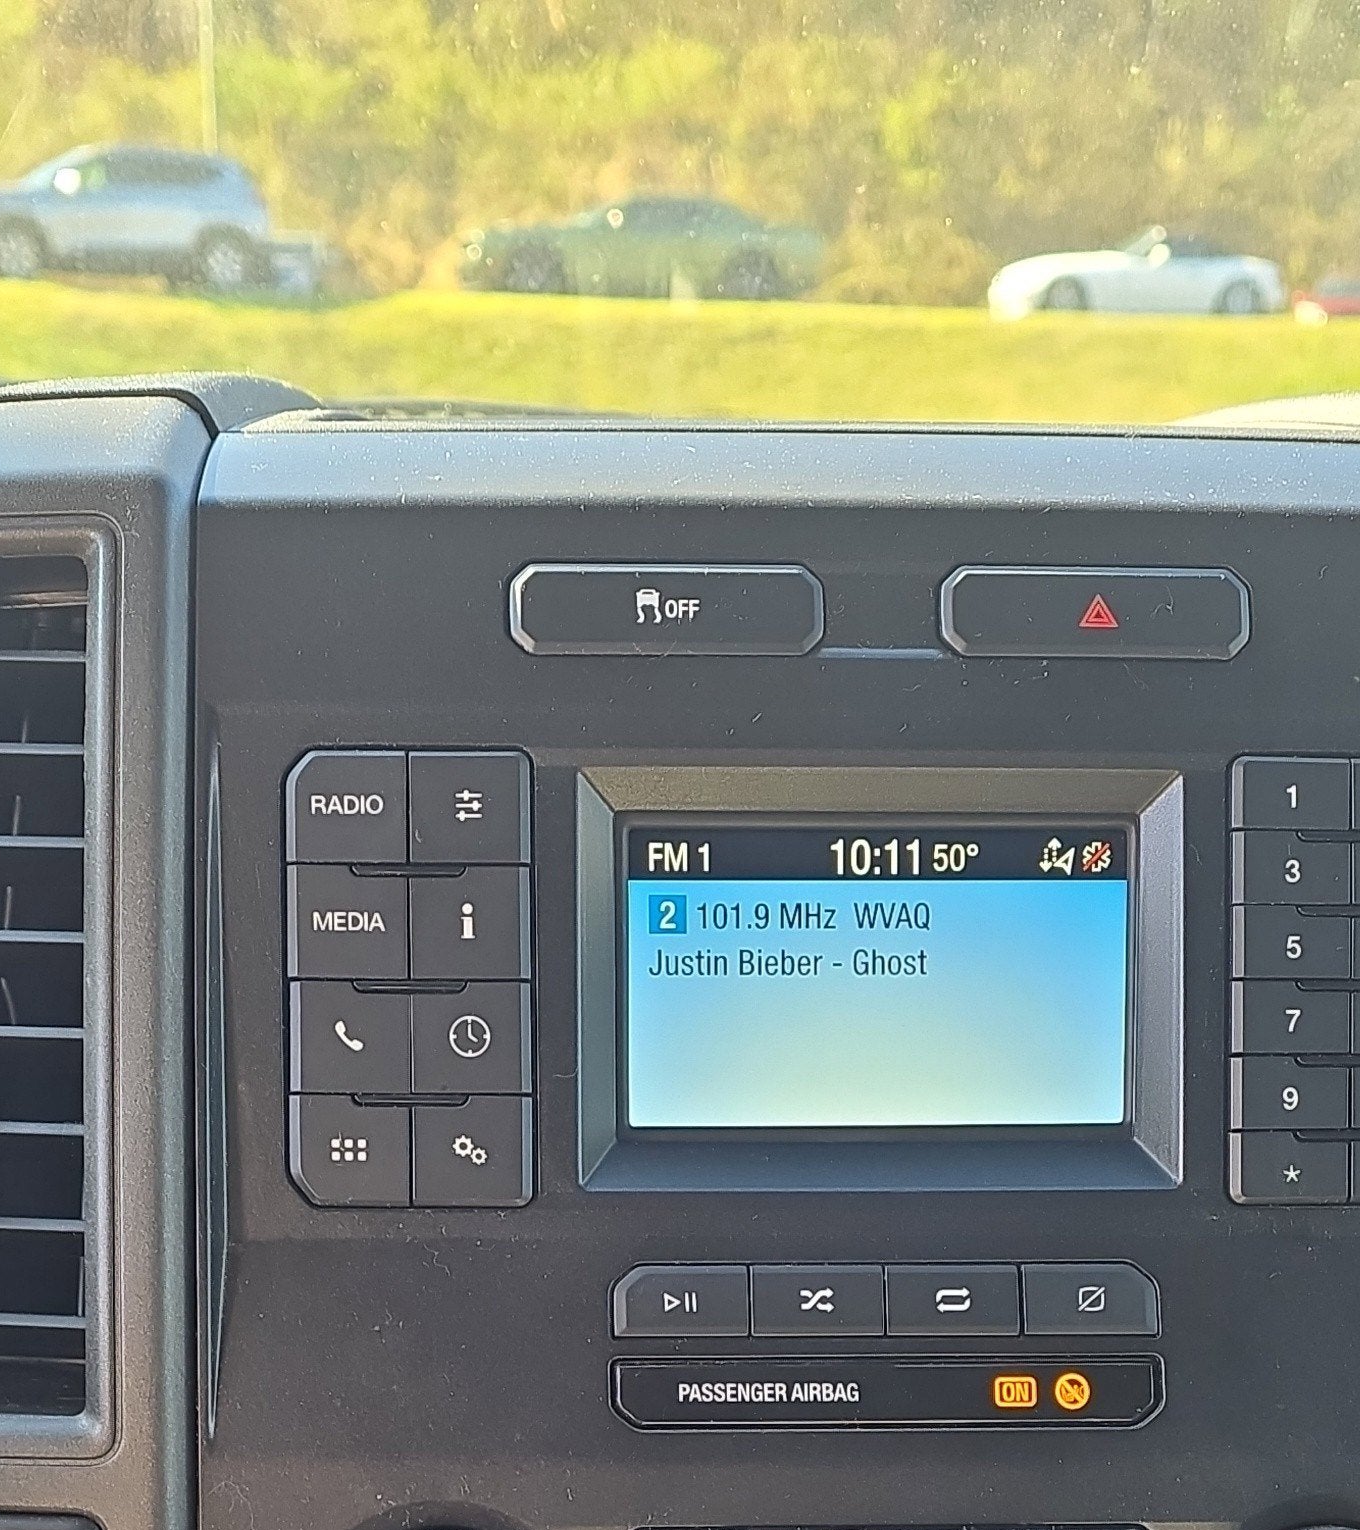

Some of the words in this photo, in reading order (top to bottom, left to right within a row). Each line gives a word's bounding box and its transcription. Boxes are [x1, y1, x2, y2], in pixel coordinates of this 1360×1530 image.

[664, 599, 701, 619] OFF
[310, 795, 384, 815] RADIO
[1285, 785, 1298, 808] 1
[648, 843, 688, 872] FM
[698, 843, 711, 872] 1
[830, 839, 921, 875] 10:11
[933, 843, 979, 872] 50°
[1284, 859, 1301, 884] 3
[313, 911, 386, 932] MEDIA
[658, 900, 677, 930] 2
[696, 902, 770, 930] 101.9
[779, 902, 837, 930] MHz
[853, 902, 932, 931] WVAQ
[1285, 935, 1302, 959] 5
[648, 949, 729, 977] Justin
[739, 949, 823, 977] Bieber
[852, 949, 928, 977] Ghost
[1284, 1009, 1302, 1032] 7
[1282, 1087, 1299, 1111] 9
[678, 1383, 788, 1402] PASSENGER
[791, 1383, 860, 1402] AIRBAG
[1001, 1382, 1030, 1402] ON
